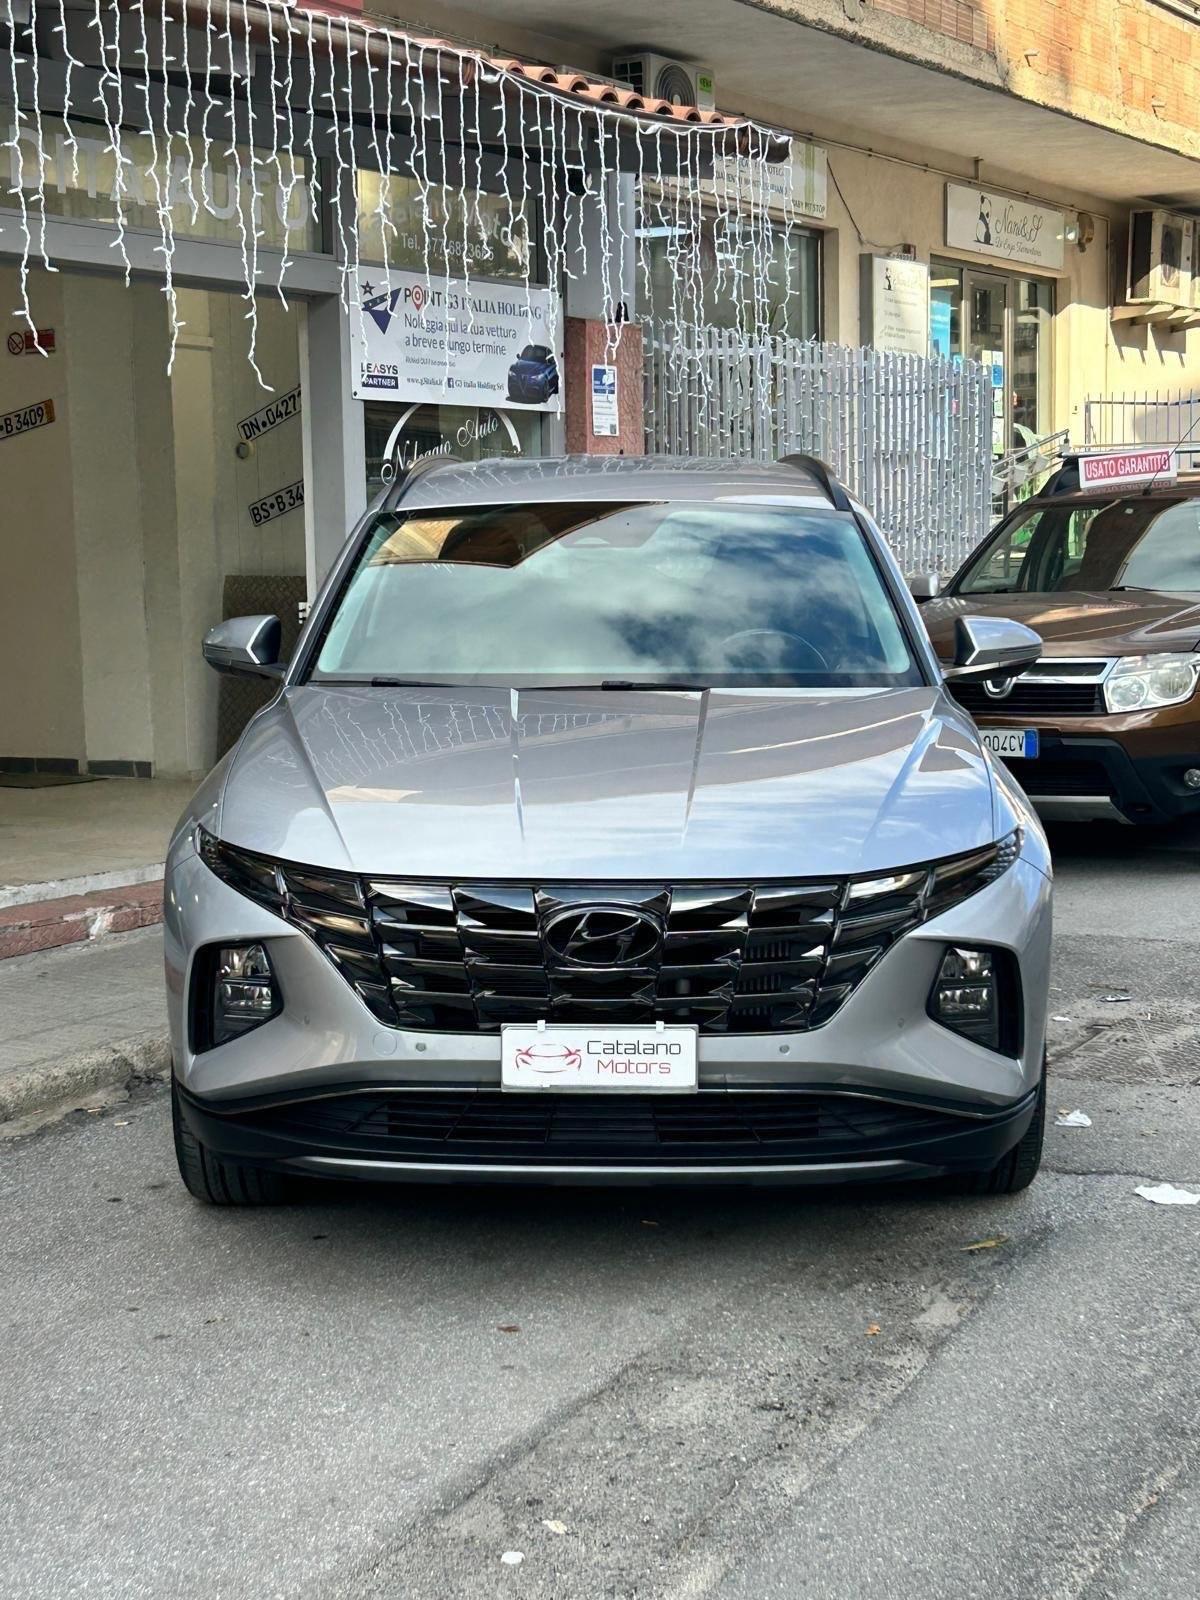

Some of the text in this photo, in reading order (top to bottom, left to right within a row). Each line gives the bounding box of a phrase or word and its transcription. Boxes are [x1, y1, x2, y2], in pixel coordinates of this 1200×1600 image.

[164, 154, 310, 230] AUTO
[401, 232, 421, 250] Tel.
[404, 285, 442, 309] POINT
[461, 296, 496, 315] ITALIA
[497, 302, 542, 320] HOLDING
[404, 313, 444, 333] Noleggia
[460, 319, 468, 334] la
[486, 324, 517, 338] vettura
[405, 337, 411, 347] a
[411, 334, 437, 350] breve
[446, 337, 470, 355] ungo
[472, 341, 507, 356] termine
[361, 362, 398, 375] LEASYS
[363, 376, 396, 387] PARTNER
[457, 408, 499, 447] Auto
[1086, 453, 1169, 479] USATO GARANTITO
[586, 1039, 682, 1056] Catalano
[597, 1058, 671, 1075] Motors
